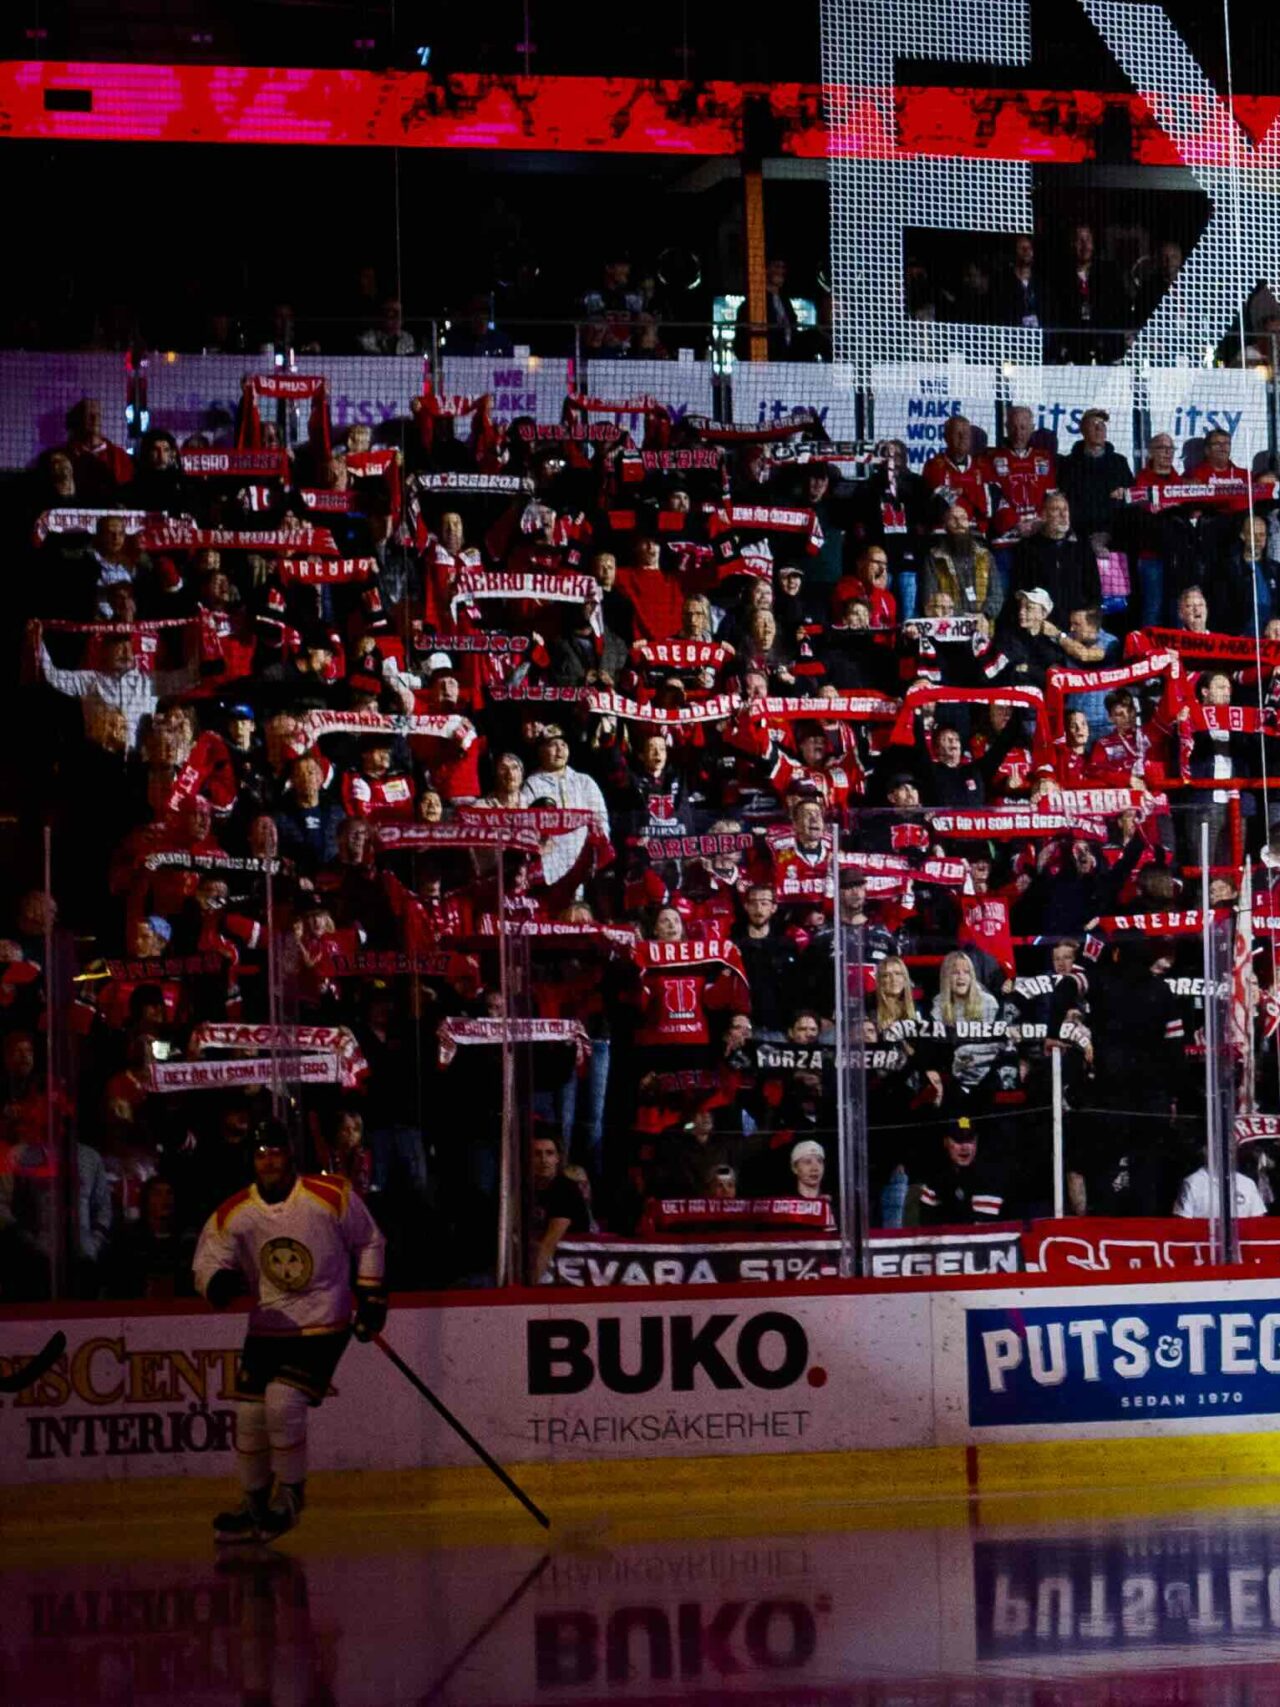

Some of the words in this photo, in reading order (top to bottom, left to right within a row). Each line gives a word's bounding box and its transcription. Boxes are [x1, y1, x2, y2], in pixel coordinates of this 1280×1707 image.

[494, 393, 537, 412] AKE
[1037, 402, 1083, 434] its
[1174, 405, 1243, 437] itsy
[988, 816, 1013, 830] SOM
[755, 1048, 823, 1070] FORZA
[211, 1067, 224, 1082] VI
[226, 1065, 253, 1081] SOM
[662, 1199, 685, 1215] DET
[708, 1199, 720, 1214] VI
[545, 1256, 720, 1288] EVARA
[1120, 1394, 1187, 1408] SEDAN
[1198, 1392, 1244, 1406] 1970
[26, 1402, 238, 1459] INTERIÖR
[527, 1409, 812, 1446] TRAFIKSÄKERHET
